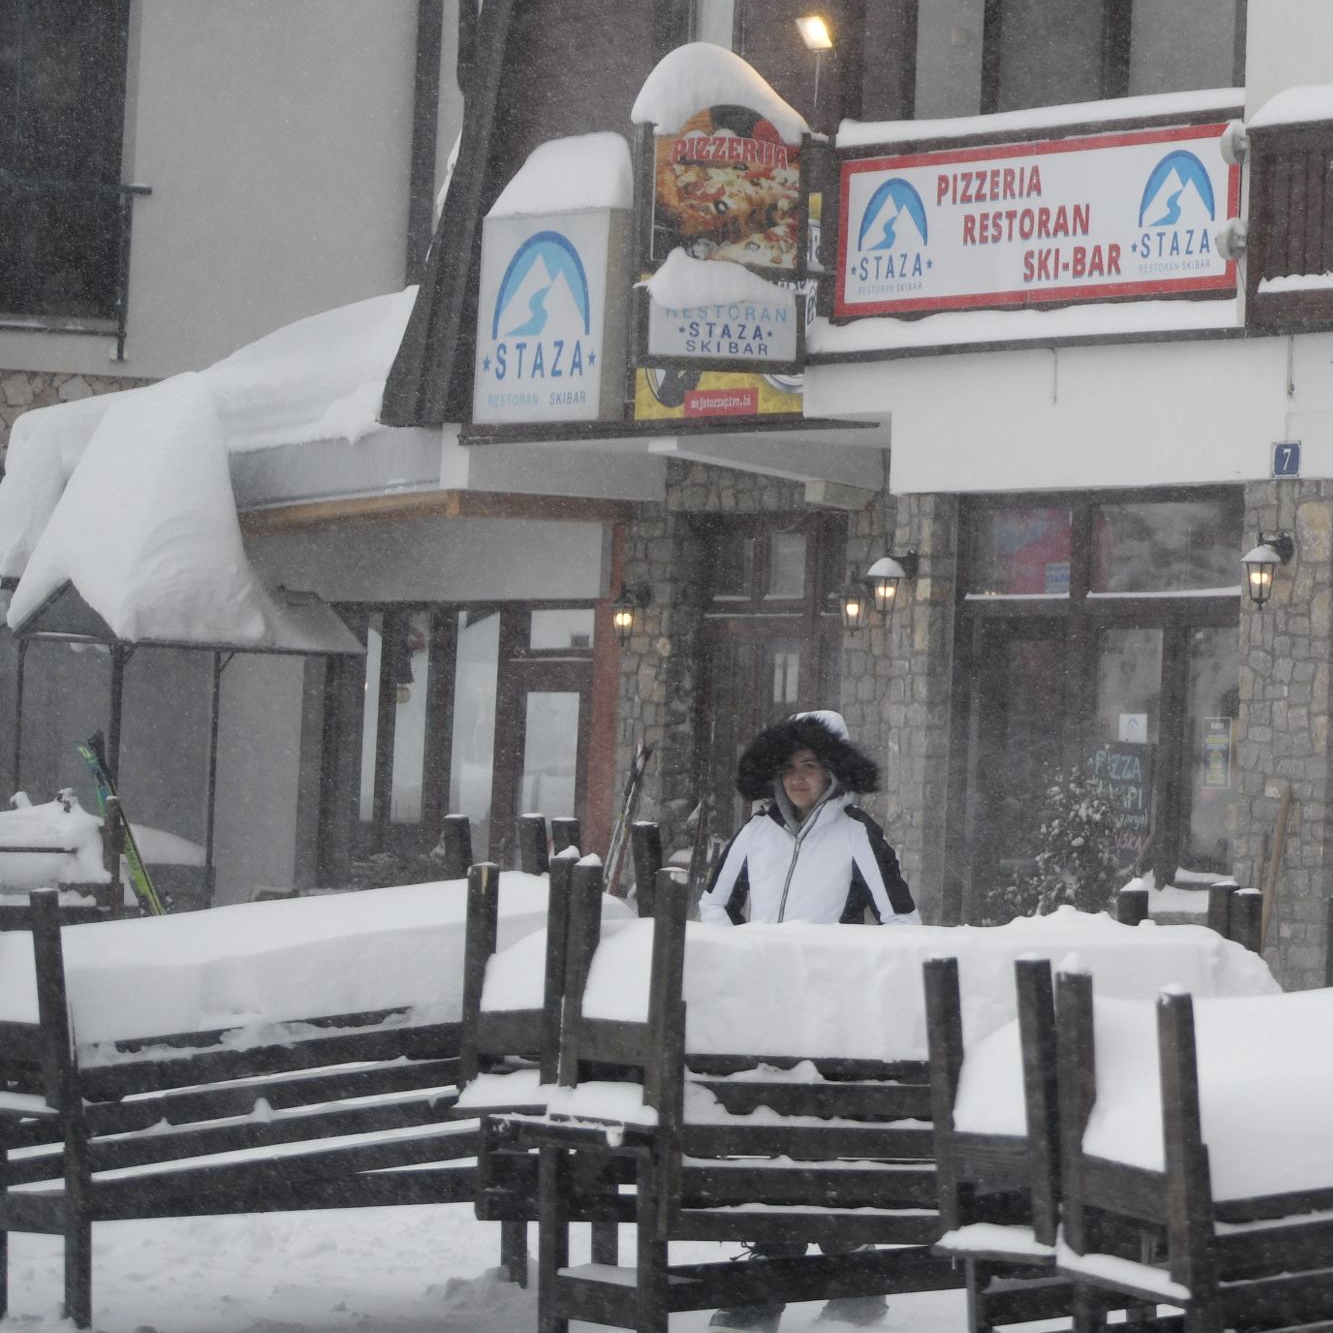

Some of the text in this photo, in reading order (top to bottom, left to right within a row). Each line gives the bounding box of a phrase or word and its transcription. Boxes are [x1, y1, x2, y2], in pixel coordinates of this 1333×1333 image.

[671, 136, 789, 170] PIZZERIJA
[936, 164, 1042, 207] PIZZERIA
[962, 203, 1090, 247] RESTORAN
[1140, 228, 1211, 259] STAZA
[859, 252, 923, 282] STAZA
[1023, 243, 1122, 283] SKI-BAR
[1138, 263, 1179, 274] RESTORAN
[857, 285, 894, 295] RESTORAN
[688, 321, 764, 341] STAZA
[494, 339, 584, 380] STAZA
[487, 390, 587, 406] RESTORAN SKIBAR
[1282, 448, 1292, 471] 7
